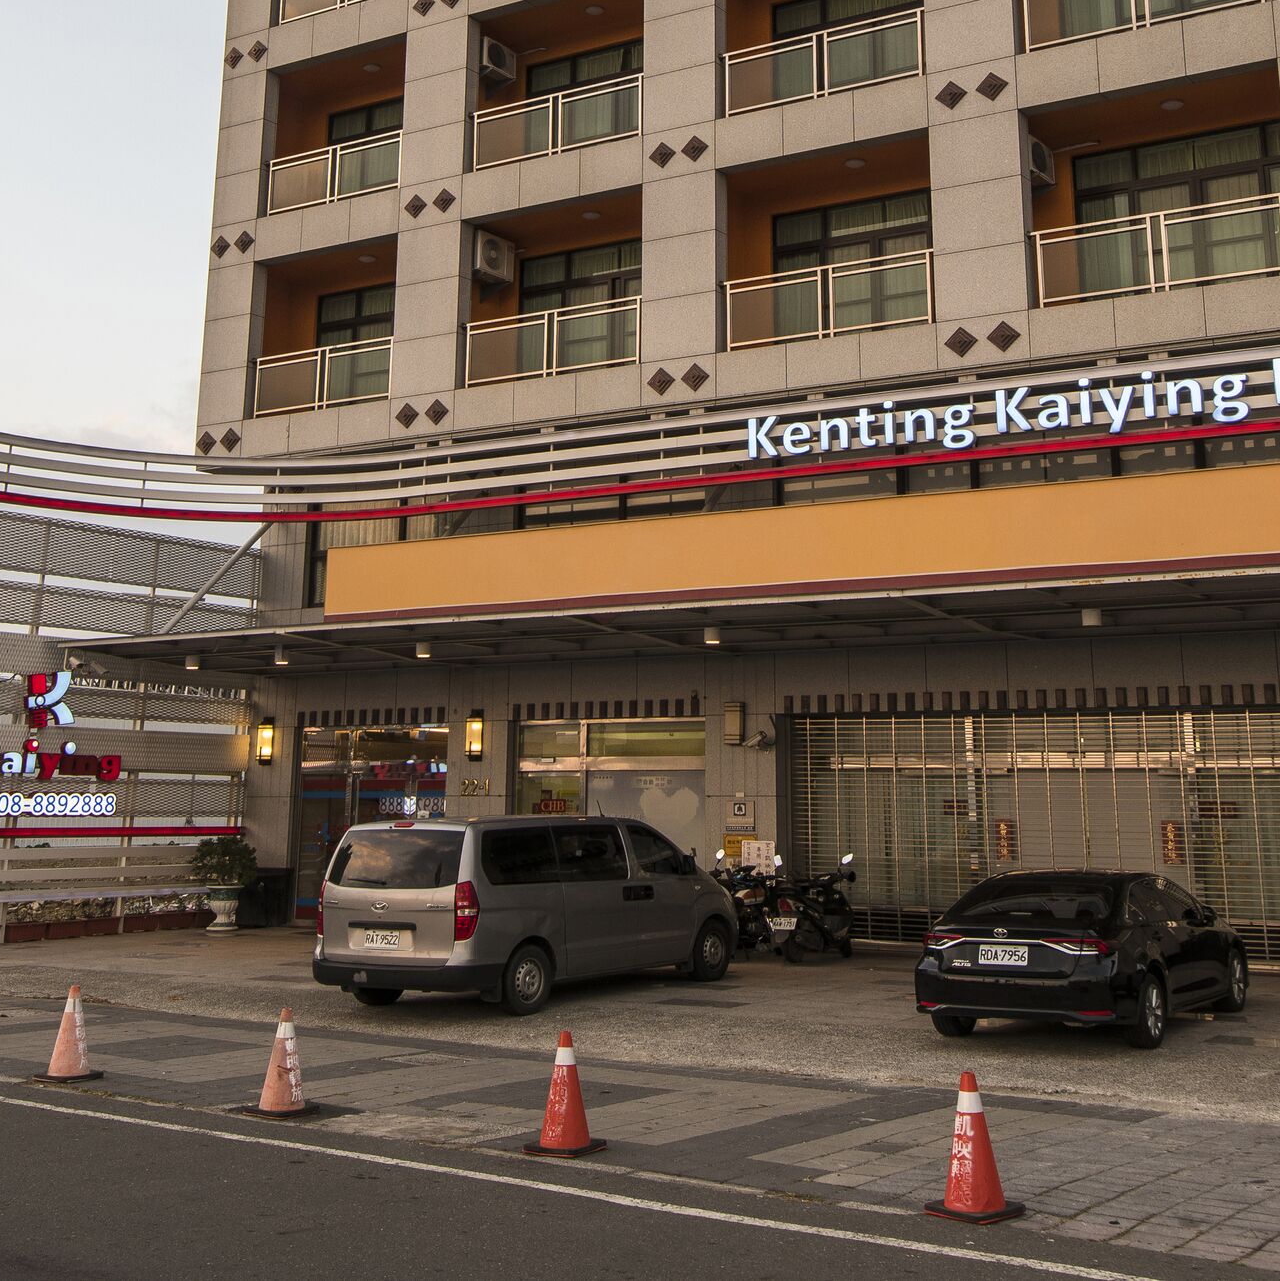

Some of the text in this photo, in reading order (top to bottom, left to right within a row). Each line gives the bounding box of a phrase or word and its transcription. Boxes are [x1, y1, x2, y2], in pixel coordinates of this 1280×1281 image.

[746, 400, 975, 460] Kenting
[994, 371, 1249, 434] Kaiying
[460, 778, 490, 797] 22-1
[540, 800, 566, 812] CHB
[364, 933, 399, 946] RAT-9522
[979, 948, 1027, 962] RDA-7956
